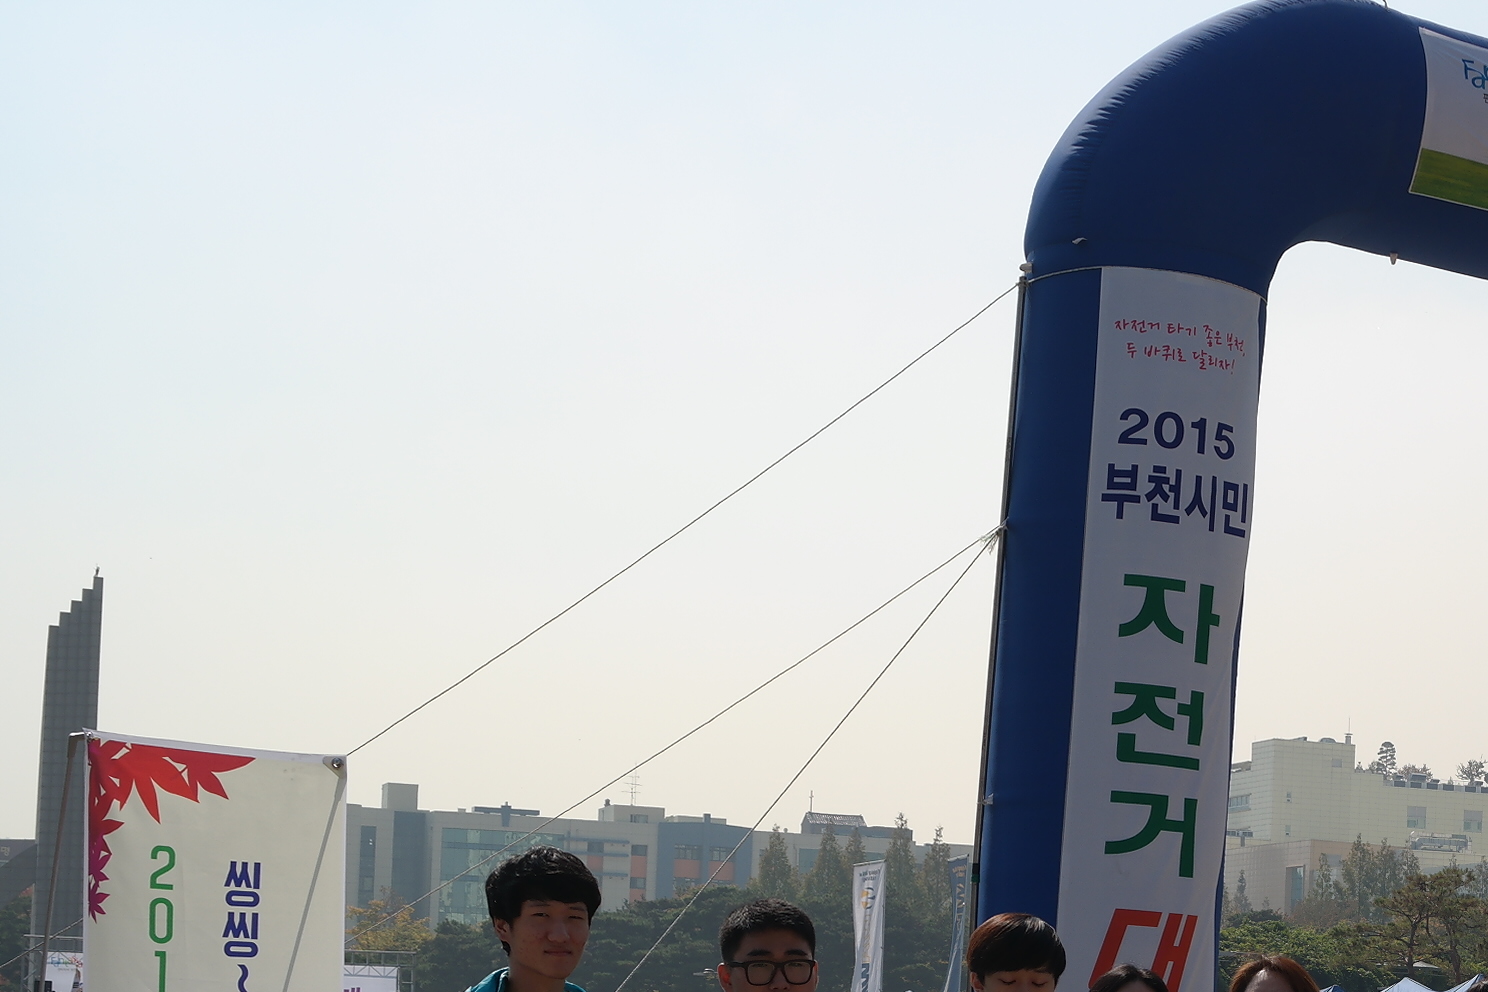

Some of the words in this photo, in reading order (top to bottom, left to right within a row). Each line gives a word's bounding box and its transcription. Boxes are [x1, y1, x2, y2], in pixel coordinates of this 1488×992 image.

[1114, 318, 1160, 334] 자전거
[1167, 322, 1197, 337] 타기
[1203, 324, 1223, 348] 좋은
[1126, 342, 1138, 358] 두
[1144, 345, 1187, 362] 바퀴로
[1192, 350, 1236, 375] 달리자!
[1117, 407, 1236, 460] 2015
[1101, 463, 1248, 539] 부천시민
[1104, 573, 1220, 879] 자전거
